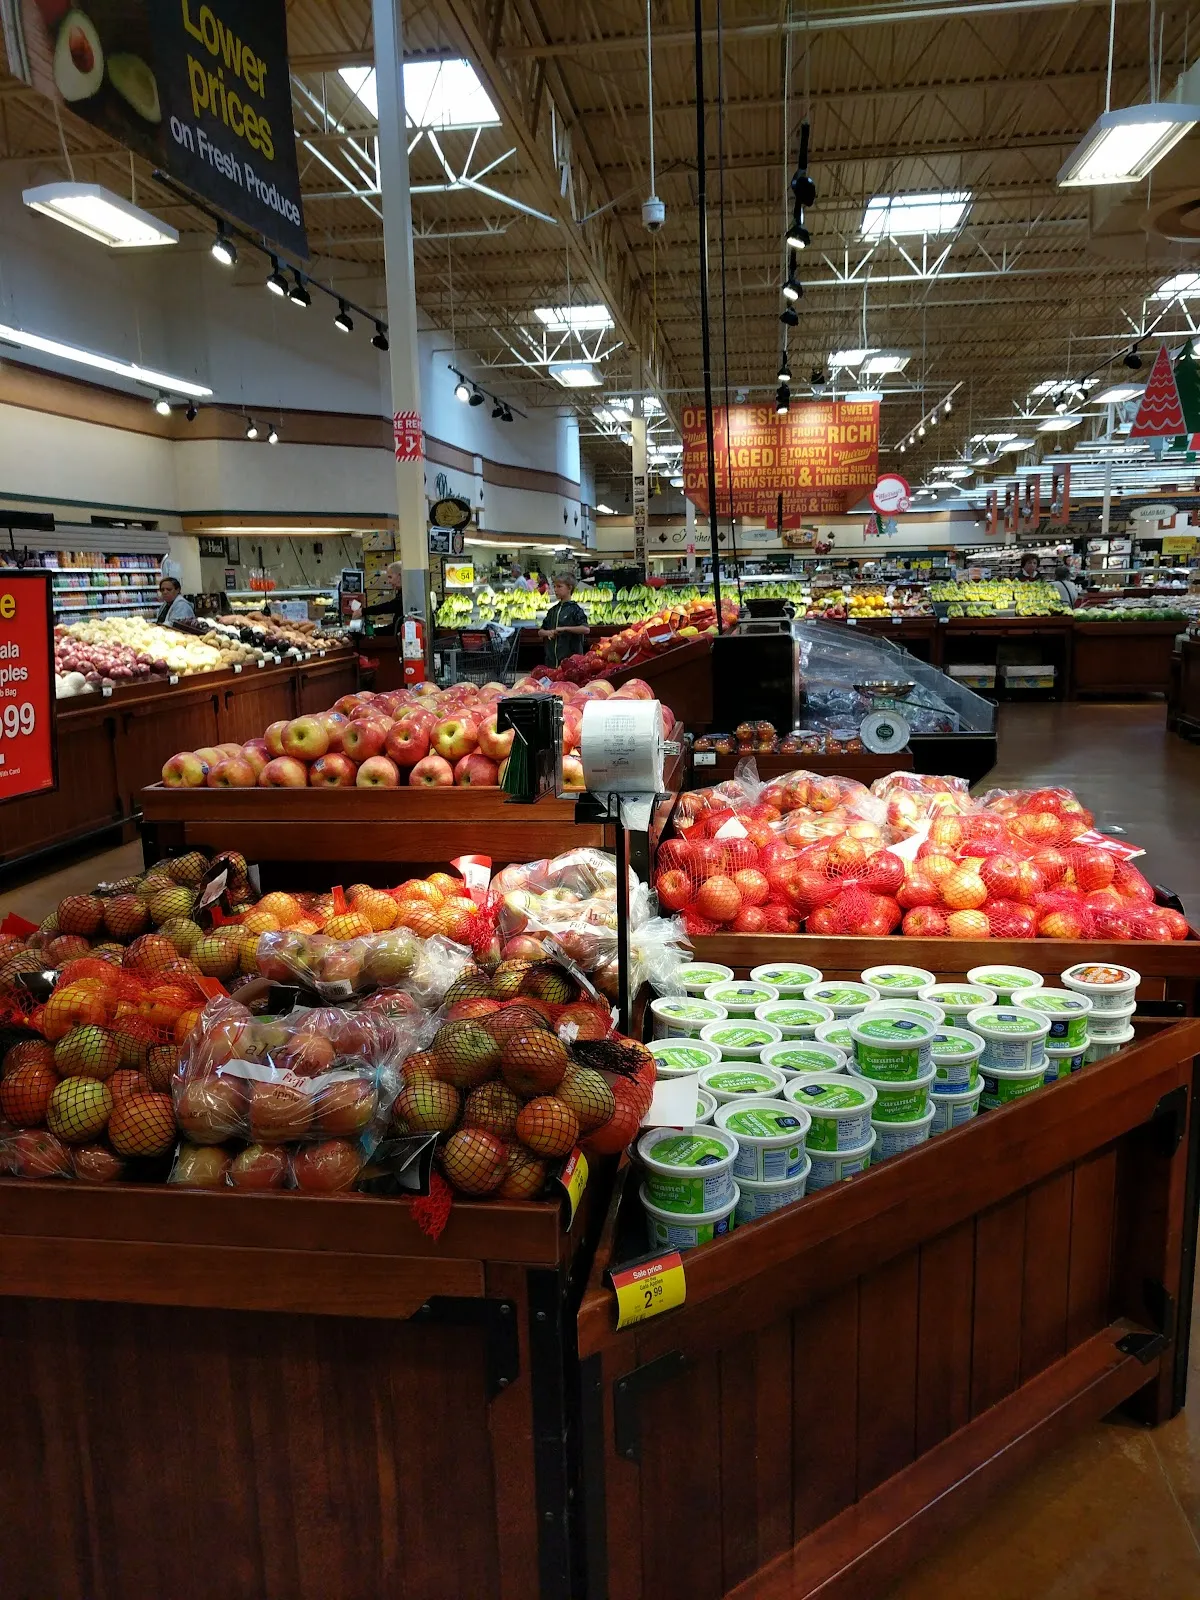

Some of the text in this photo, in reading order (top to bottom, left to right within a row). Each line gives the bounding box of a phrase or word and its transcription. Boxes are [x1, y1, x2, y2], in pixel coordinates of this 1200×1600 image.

[181, 0, 269, 100] Lower
[186, 52, 276, 161] prices
[170, 114, 301, 227] on Fresh Produce
[840, 404, 874, 415] SWEET
[791, 426, 826, 437] FRUITY
[827, 424, 872, 443] RICH
[729, 436, 777, 447] LUSCIOUS
[725, 448, 774, 468] AGED
[789, 447, 827, 458] TOASTY
[757, 467, 796, 475] DECADENT
[850, 465, 876, 473] SUBTLE
[798, 466, 813, 487] &
[815, 473, 876, 486] LINGERING
[5, 688, 17, 697] Bag
[866, 1056, 905, 1064] caramel
[888, 1062, 899, 1070] dip
[1009, 1081, 1042, 1096] caramel
[879, 1096, 918, 1108] caramel
[632, 1264, 663, 1279] Sale price
[644, 1286, 663, 1308] 2 99
